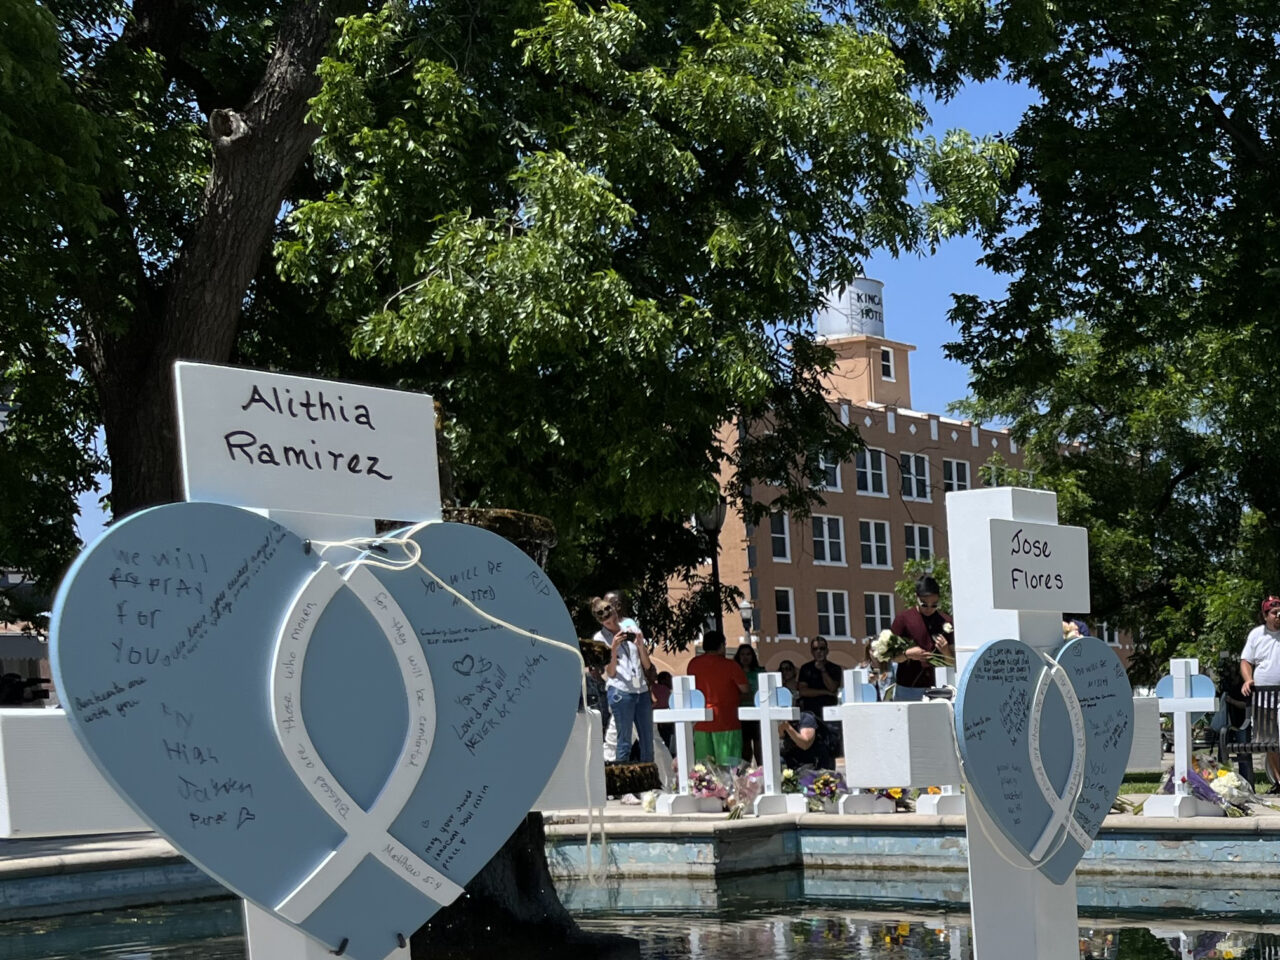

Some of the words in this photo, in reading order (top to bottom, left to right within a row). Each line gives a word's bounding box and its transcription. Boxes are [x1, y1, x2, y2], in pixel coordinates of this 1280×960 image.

[241, 385, 376, 430] Alithia
[223, 430, 393, 480] Ramirez
[1011, 529, 1052, 558] Jose
[1011, 568, 1064, 590] Flores
[284, 651, 296, 680] who
